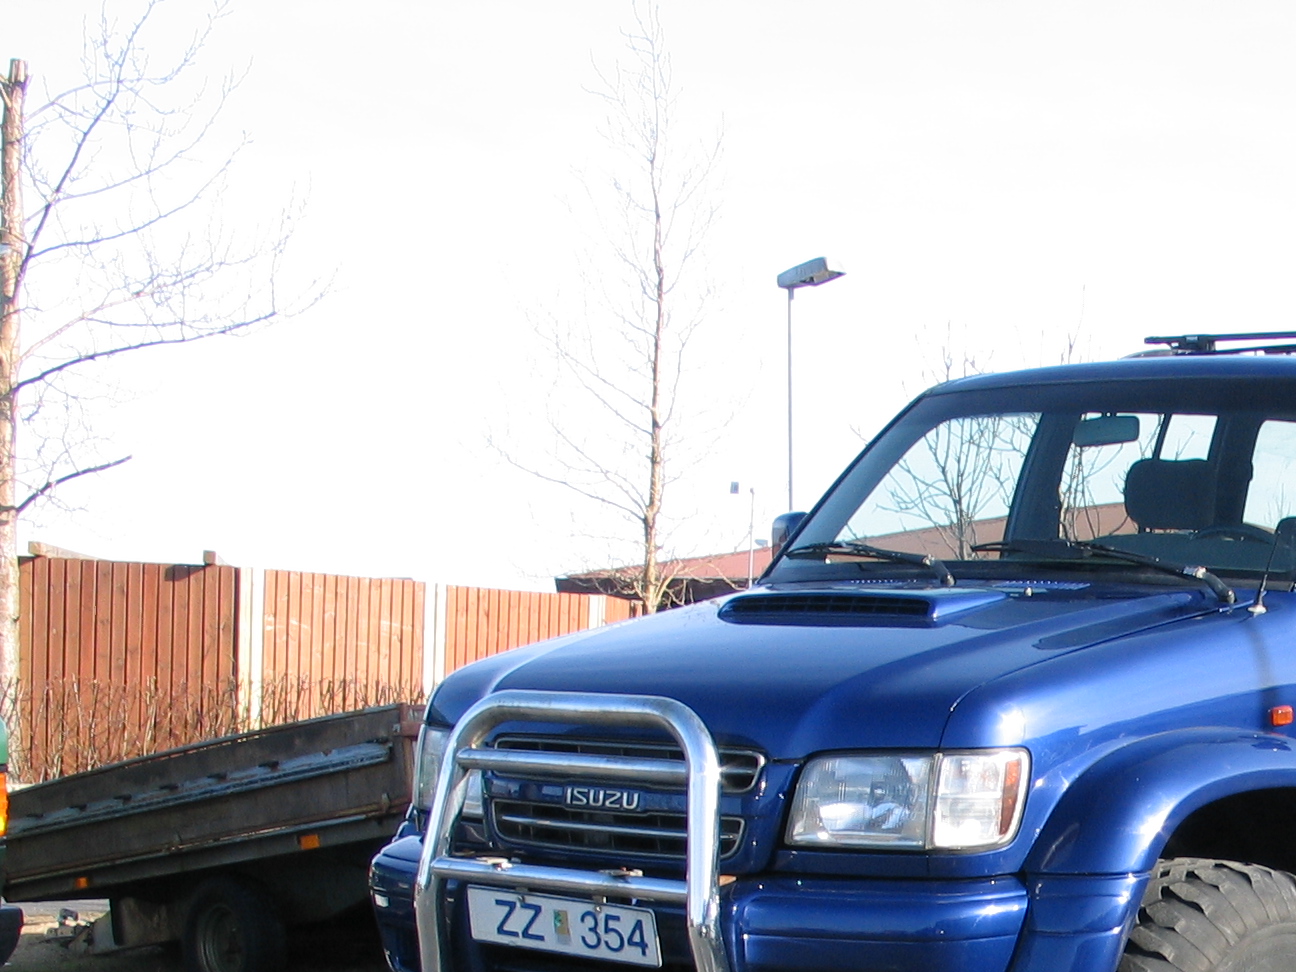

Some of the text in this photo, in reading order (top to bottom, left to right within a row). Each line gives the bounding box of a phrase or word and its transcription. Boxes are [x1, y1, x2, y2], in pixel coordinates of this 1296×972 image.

[566, 787, 639, 810] ISUZU
[495, 899, 648, 956] ZZ 354
